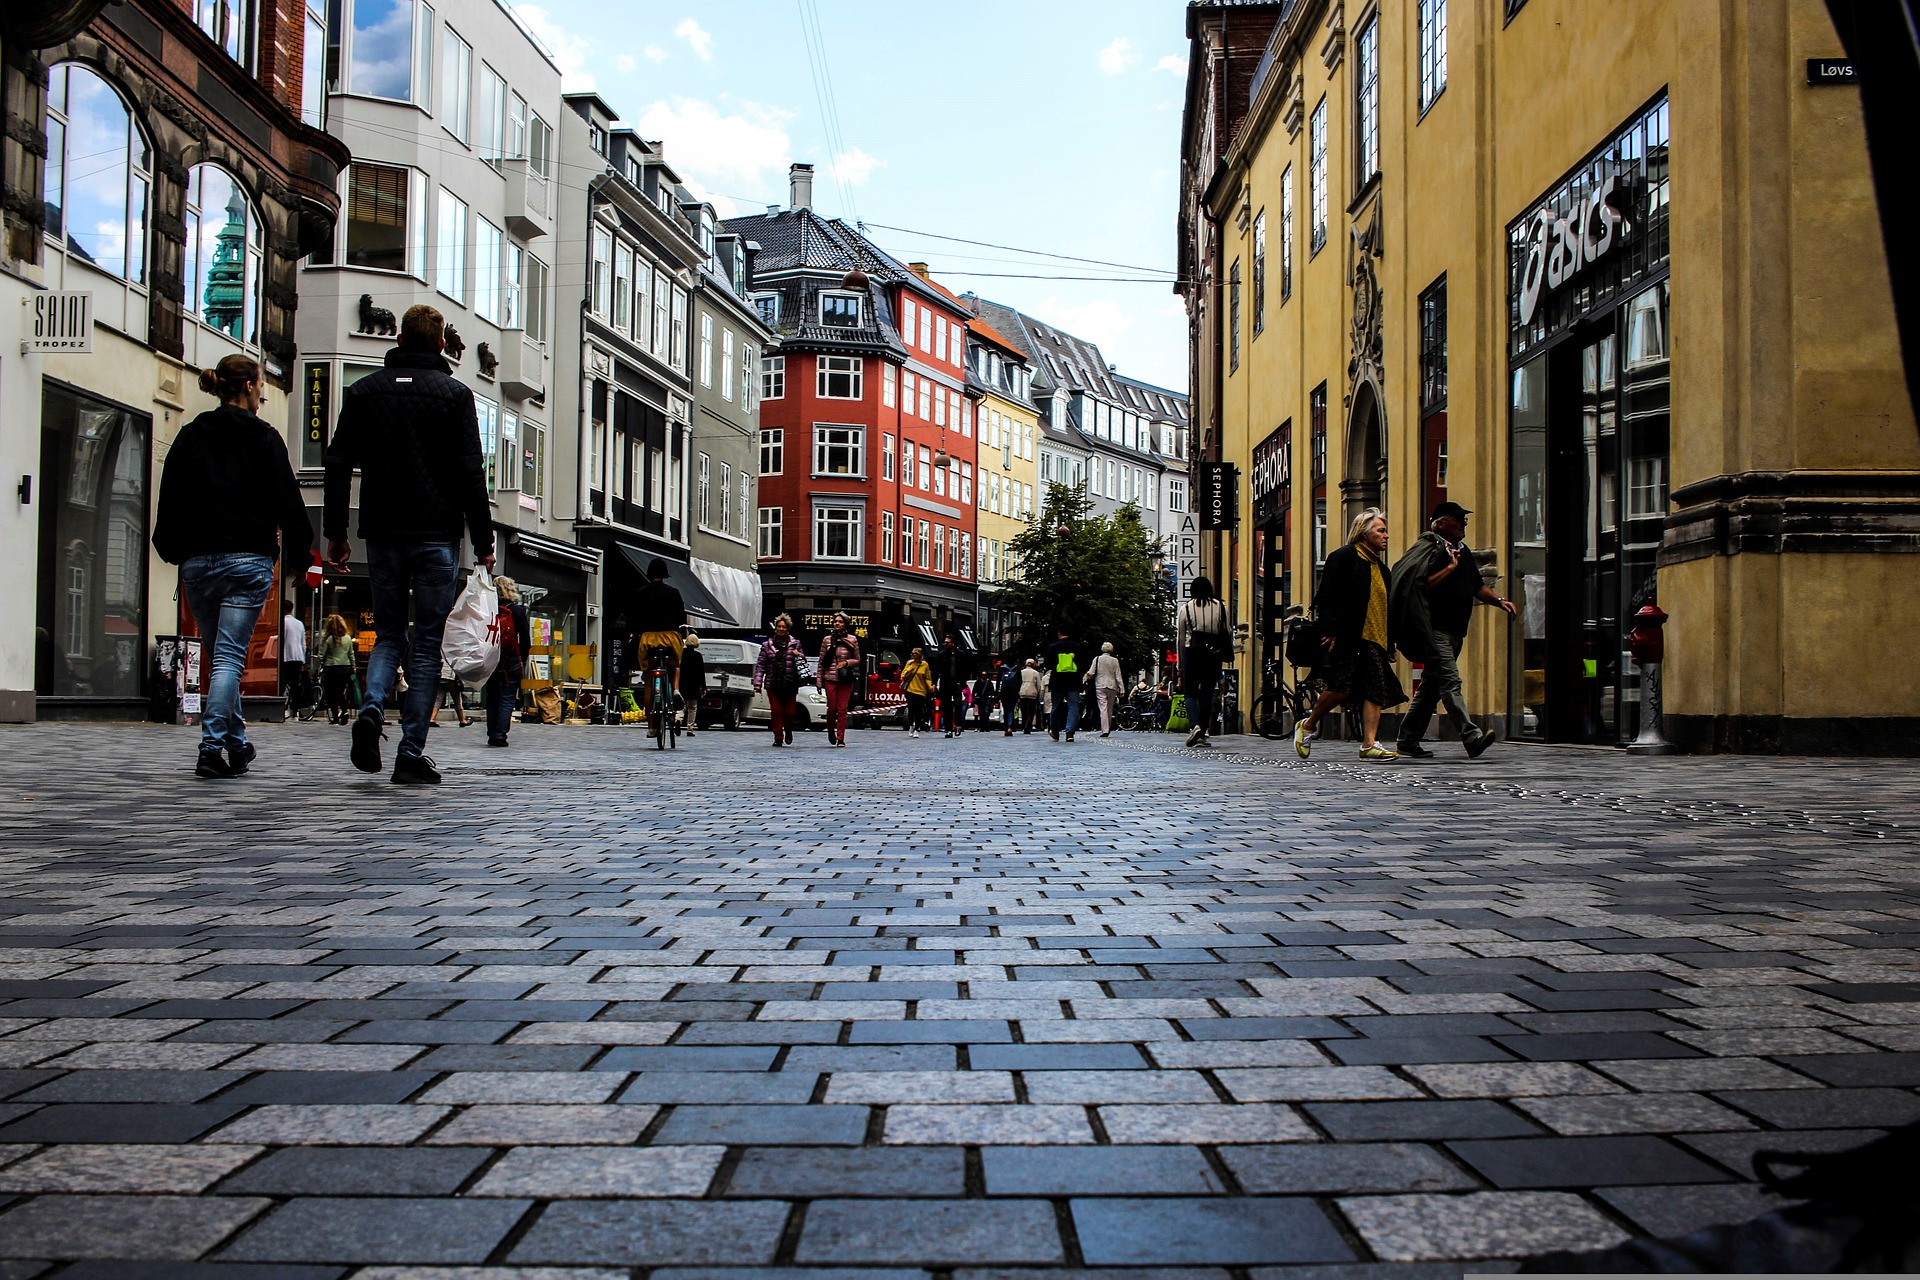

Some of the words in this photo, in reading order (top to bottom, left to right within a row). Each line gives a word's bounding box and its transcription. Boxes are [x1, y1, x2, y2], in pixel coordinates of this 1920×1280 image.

[1821, 63, 1853, 76] Løvs
[35, 295, 88, 337] SAINT
[311, 368, 321, 440] TATTOO
[1212, 467, 1222, 525] SEPHORA
[1250, 444, 1290, 504] SEPHORA
[1181, 515, 1196, 598] ARKE
[849, 616, 870, 626] RTZ
